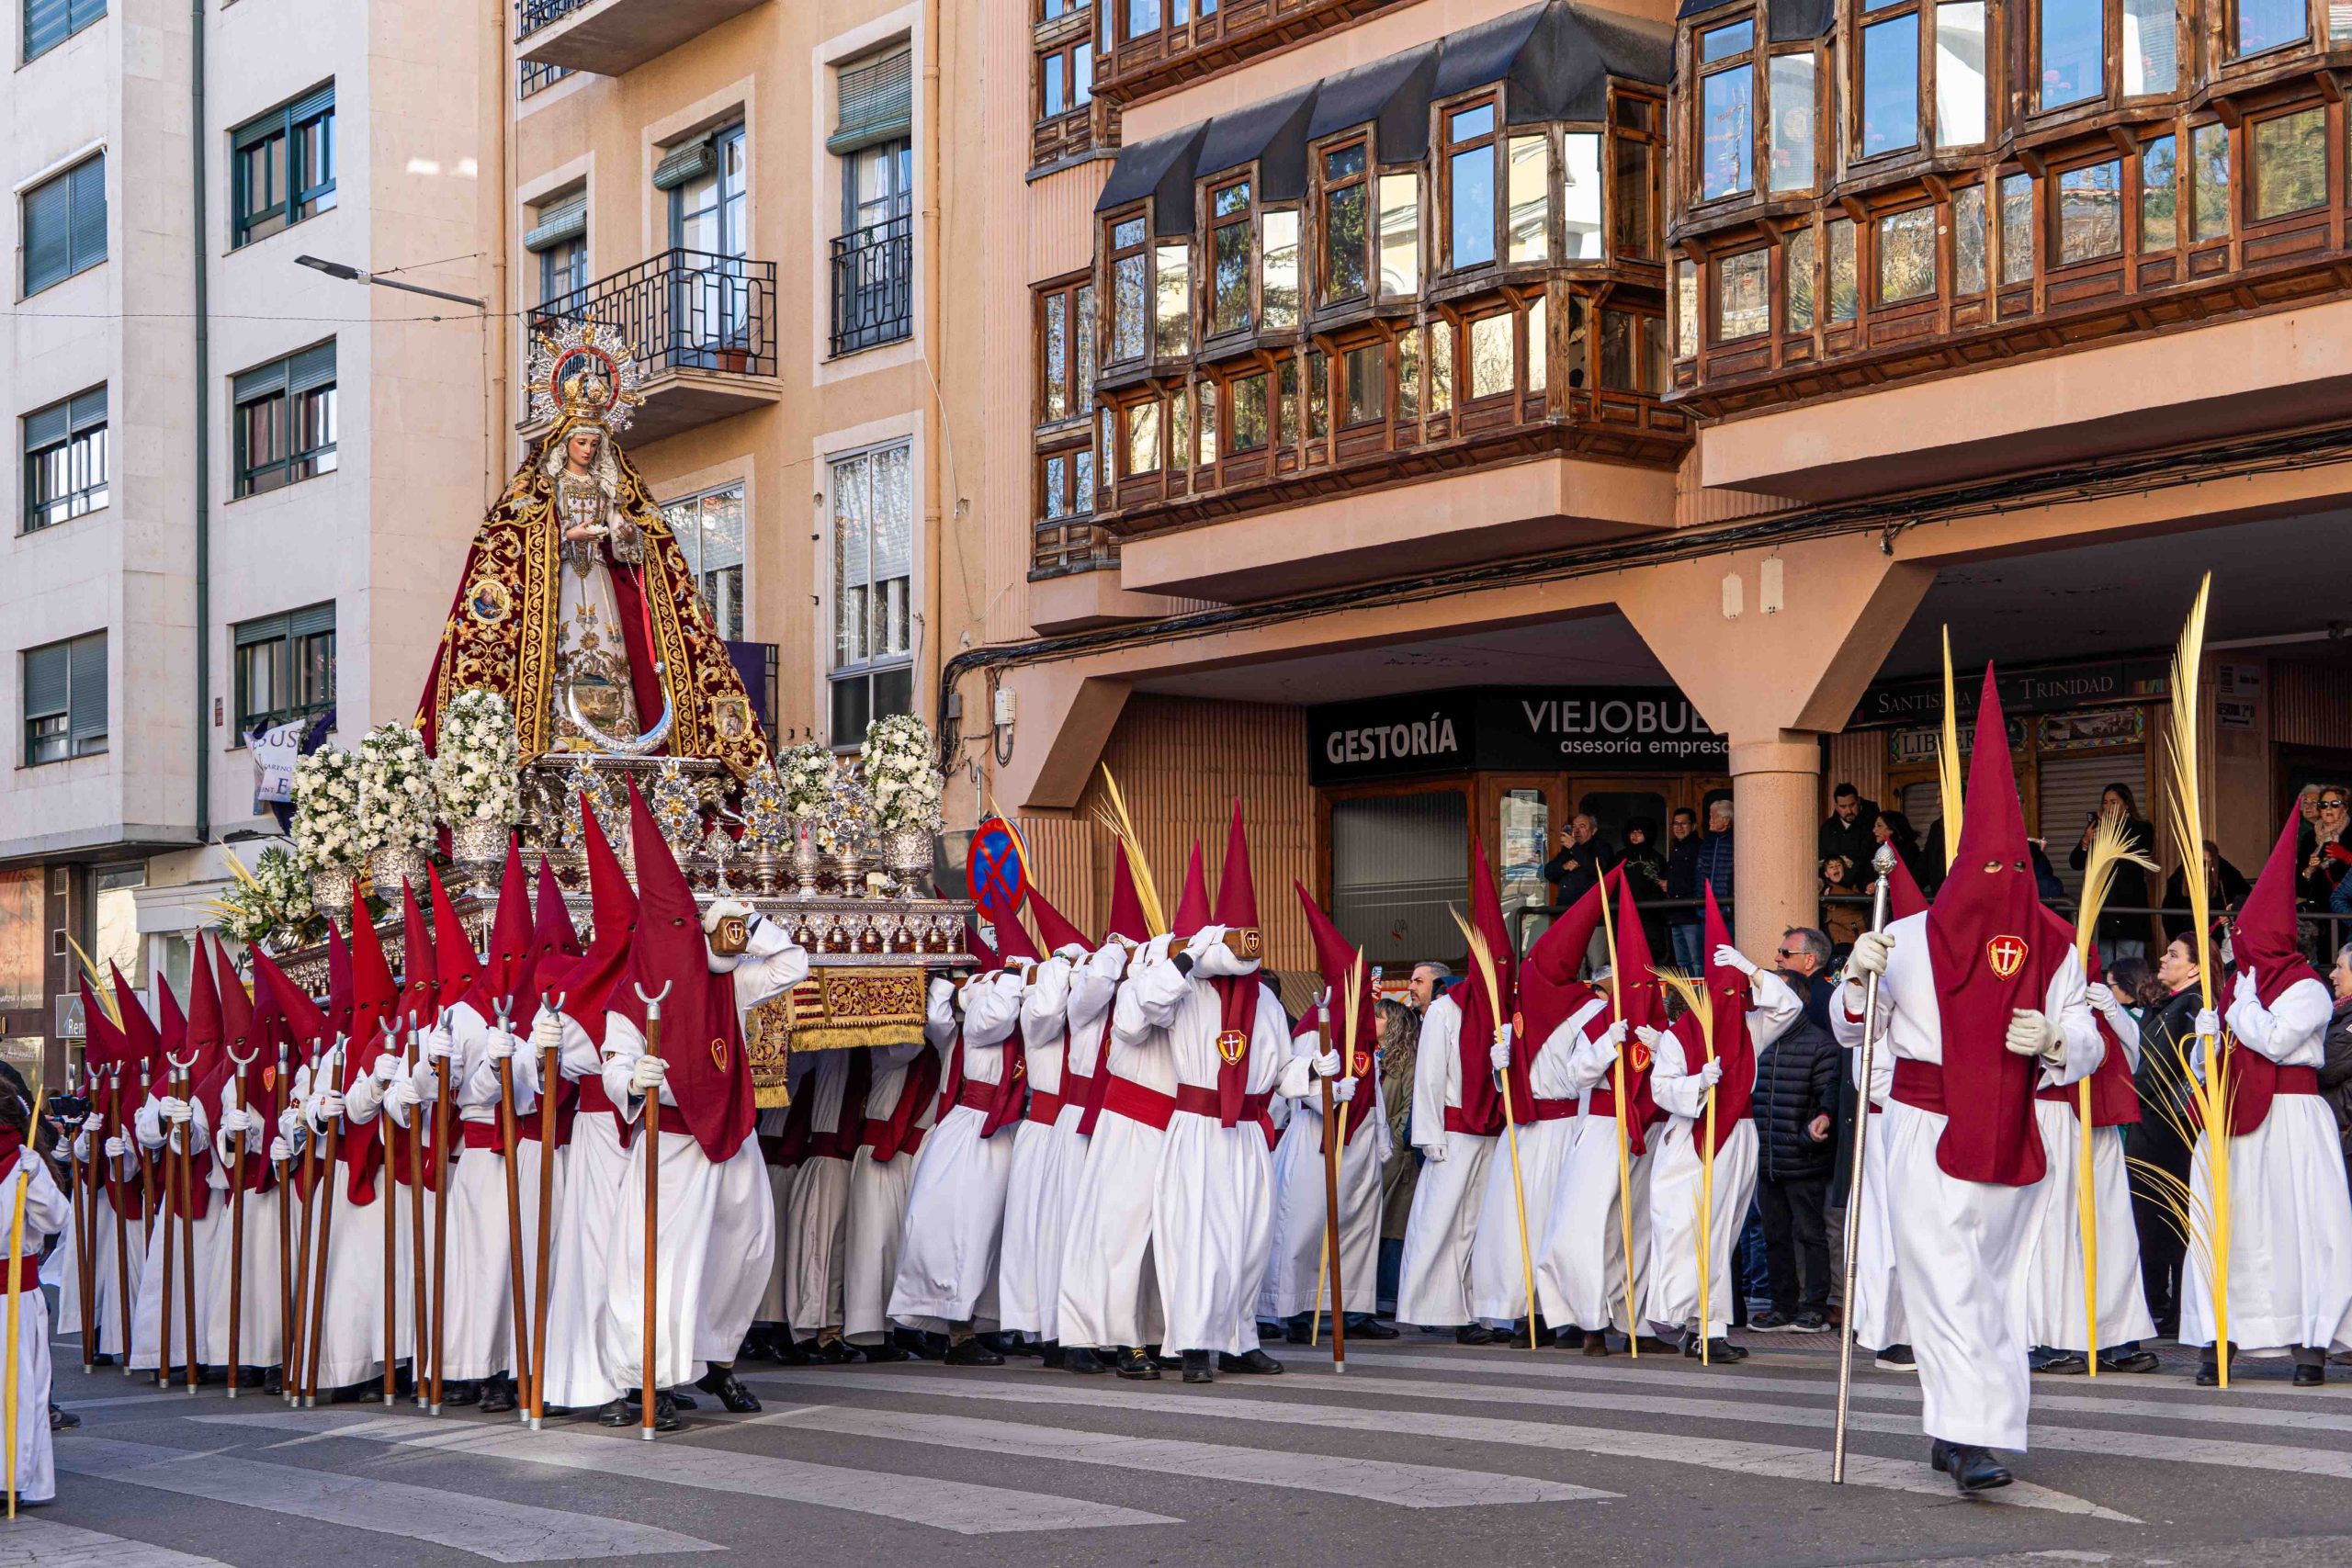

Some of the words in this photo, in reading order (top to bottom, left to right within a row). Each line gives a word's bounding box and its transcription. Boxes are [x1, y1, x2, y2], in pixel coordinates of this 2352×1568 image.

[2018, 676, 2113, 700] TRINIDAD
[1327, 711, 1458, 764] GESTORÍA
[1560, 737, 1642, 753] asesoría
[68, 1019, 86, 1035] Ren
